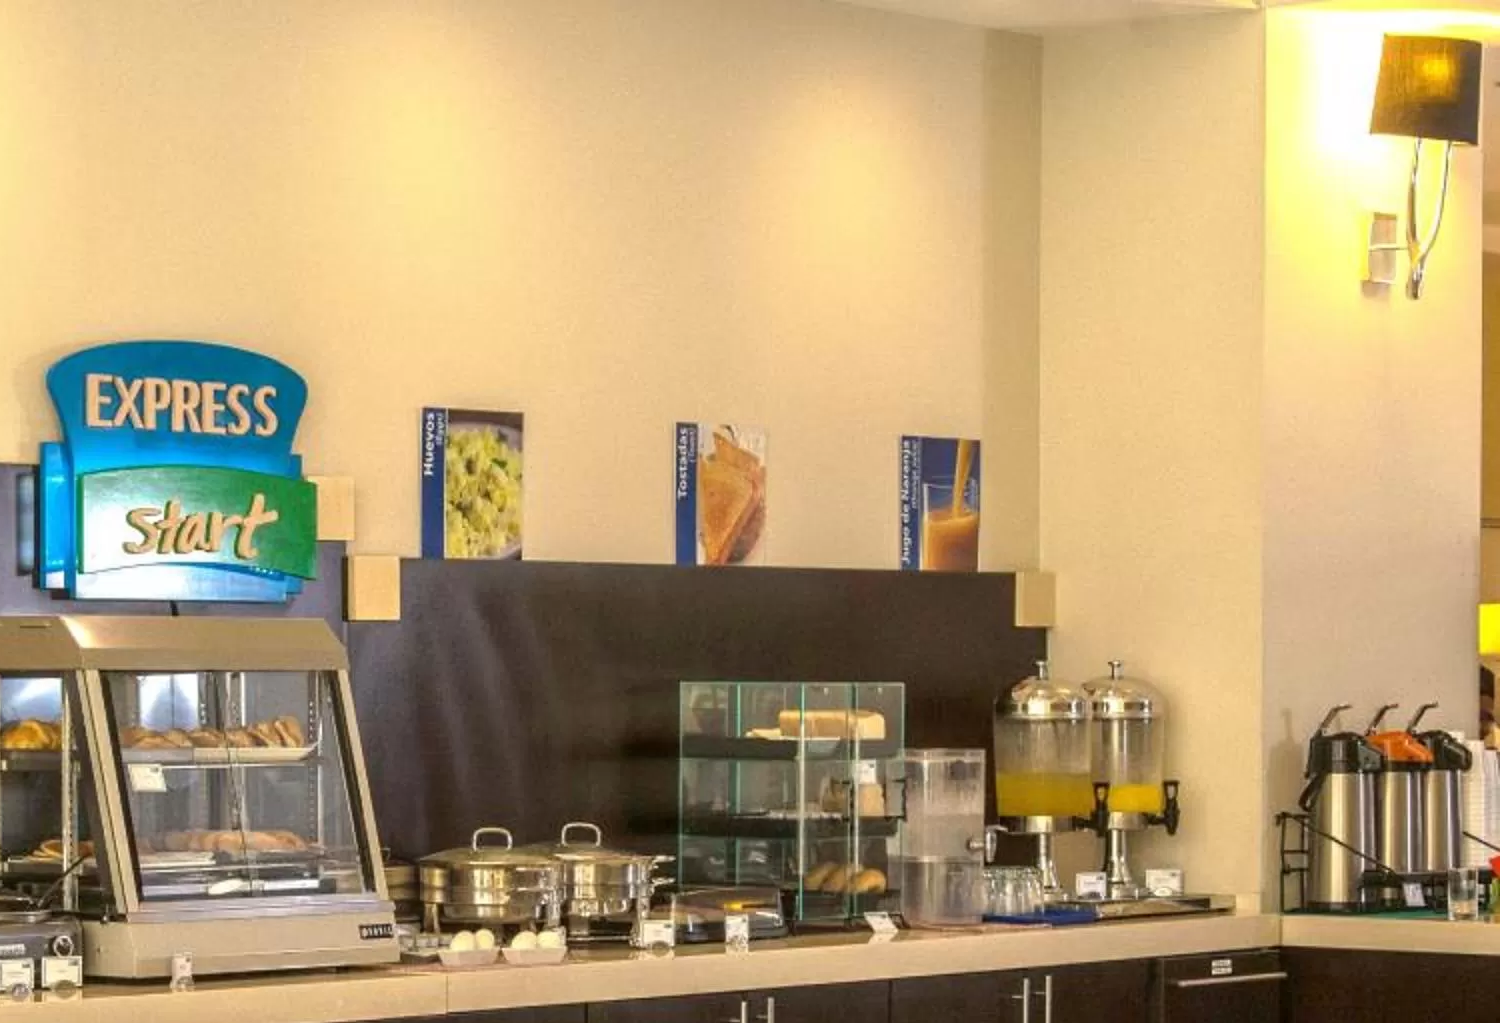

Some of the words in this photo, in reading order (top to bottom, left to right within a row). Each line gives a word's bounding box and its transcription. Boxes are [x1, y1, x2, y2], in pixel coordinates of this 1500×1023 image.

[85, 373, 279, 436] EXPRESS
[423, 412, 435, 476] Huevos
[677, 427, 688, 500] Tostadas
[900, 440, 911, 501] Naranja
[123, 493, 279, 560] Start
[900, 504, 910, 524] de
[902, 526, 912, 565] Jugo
